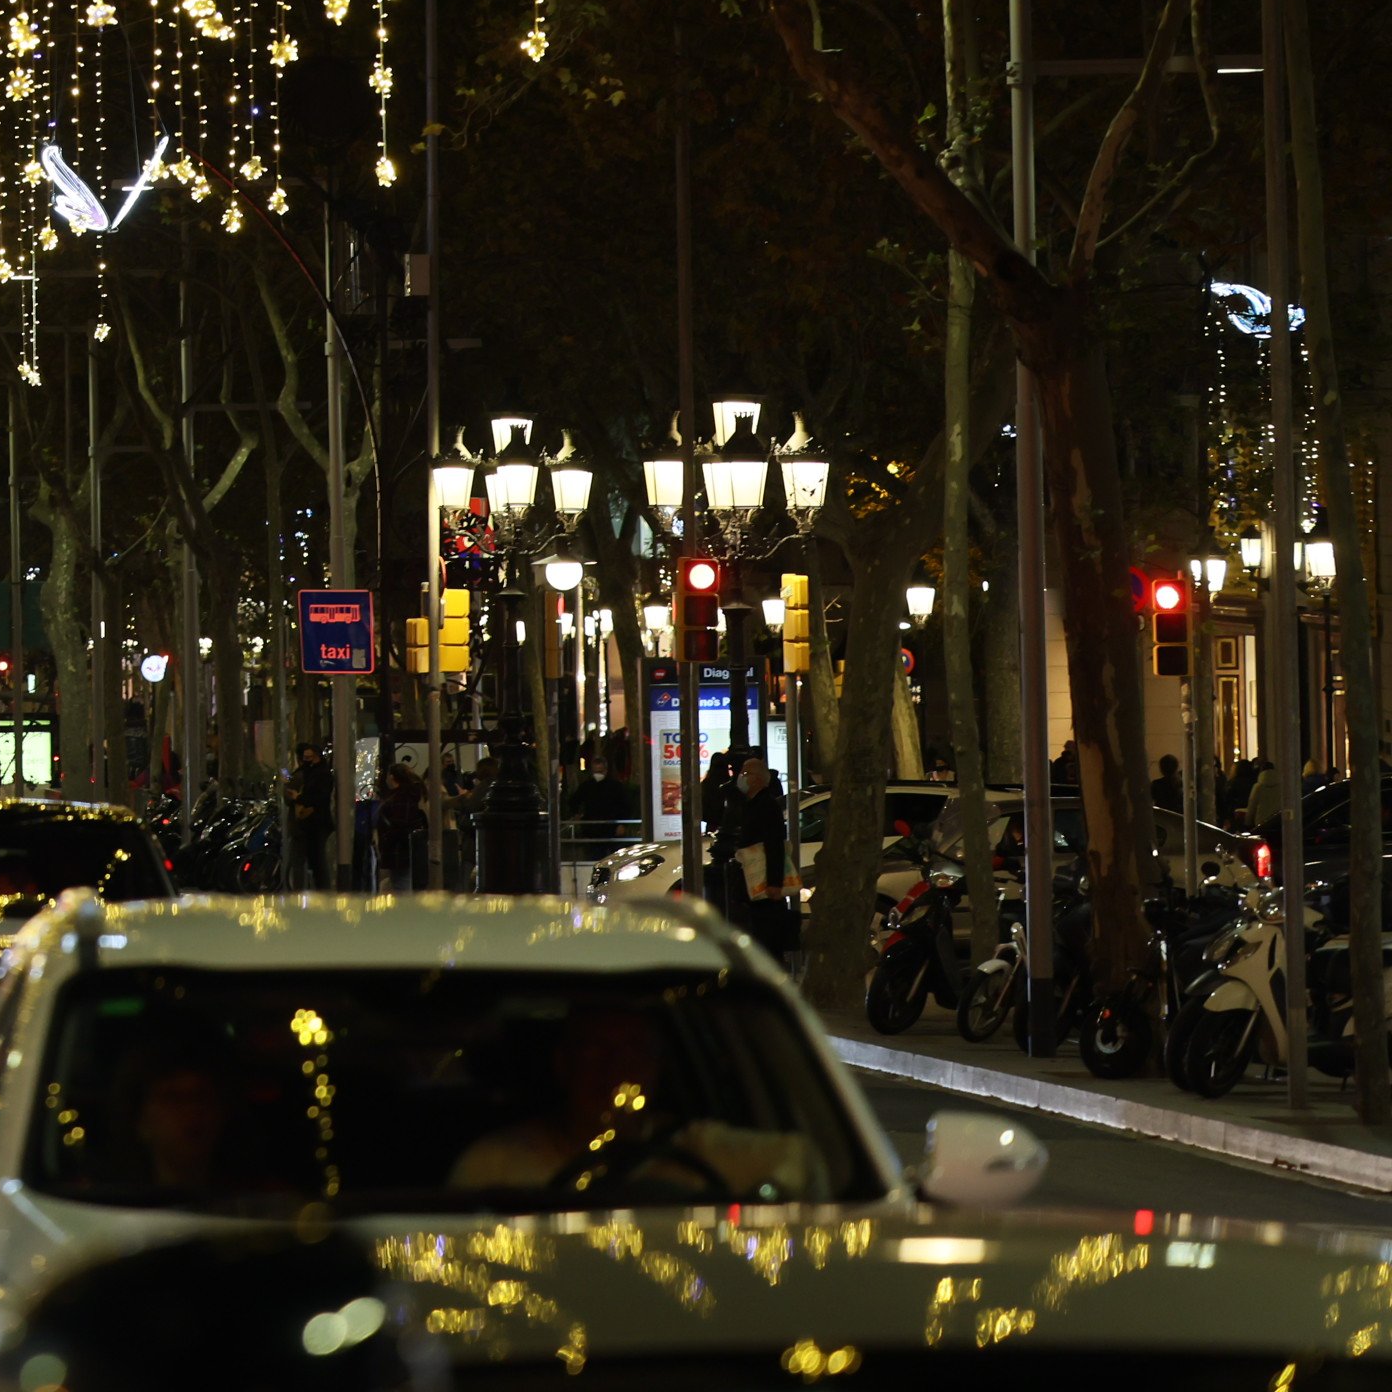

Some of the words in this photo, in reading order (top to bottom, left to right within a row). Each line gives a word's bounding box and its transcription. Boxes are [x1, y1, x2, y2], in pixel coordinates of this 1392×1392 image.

[320, 643, 351, 659] taxi
[703, 667, 754, 679] Diagal
[663, 733, 708, 744] TOO
